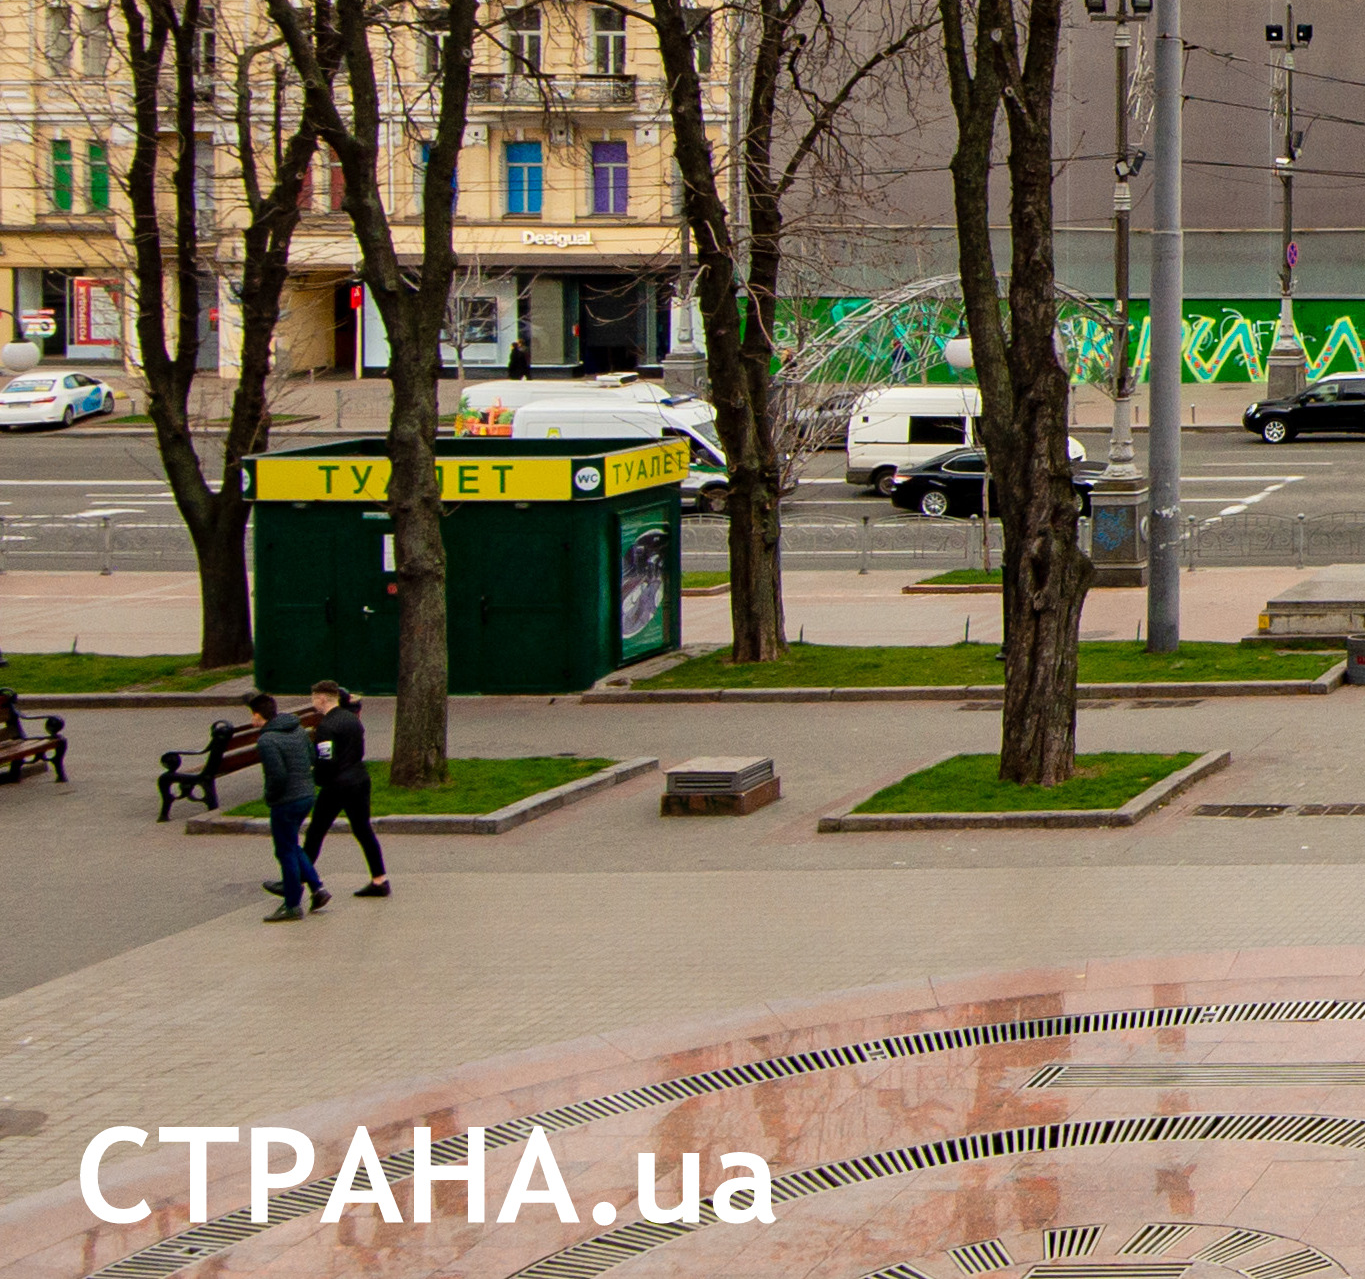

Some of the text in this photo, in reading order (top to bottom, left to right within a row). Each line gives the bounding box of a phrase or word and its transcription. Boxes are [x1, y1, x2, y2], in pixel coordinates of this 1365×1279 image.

[522, 230, 593, 249] Desigual
[318, 465, 514, 494] ТУЕТ
[577, 473, 599, 483] WC
[612, 451, 684, 485] ТУАЛЕТ
